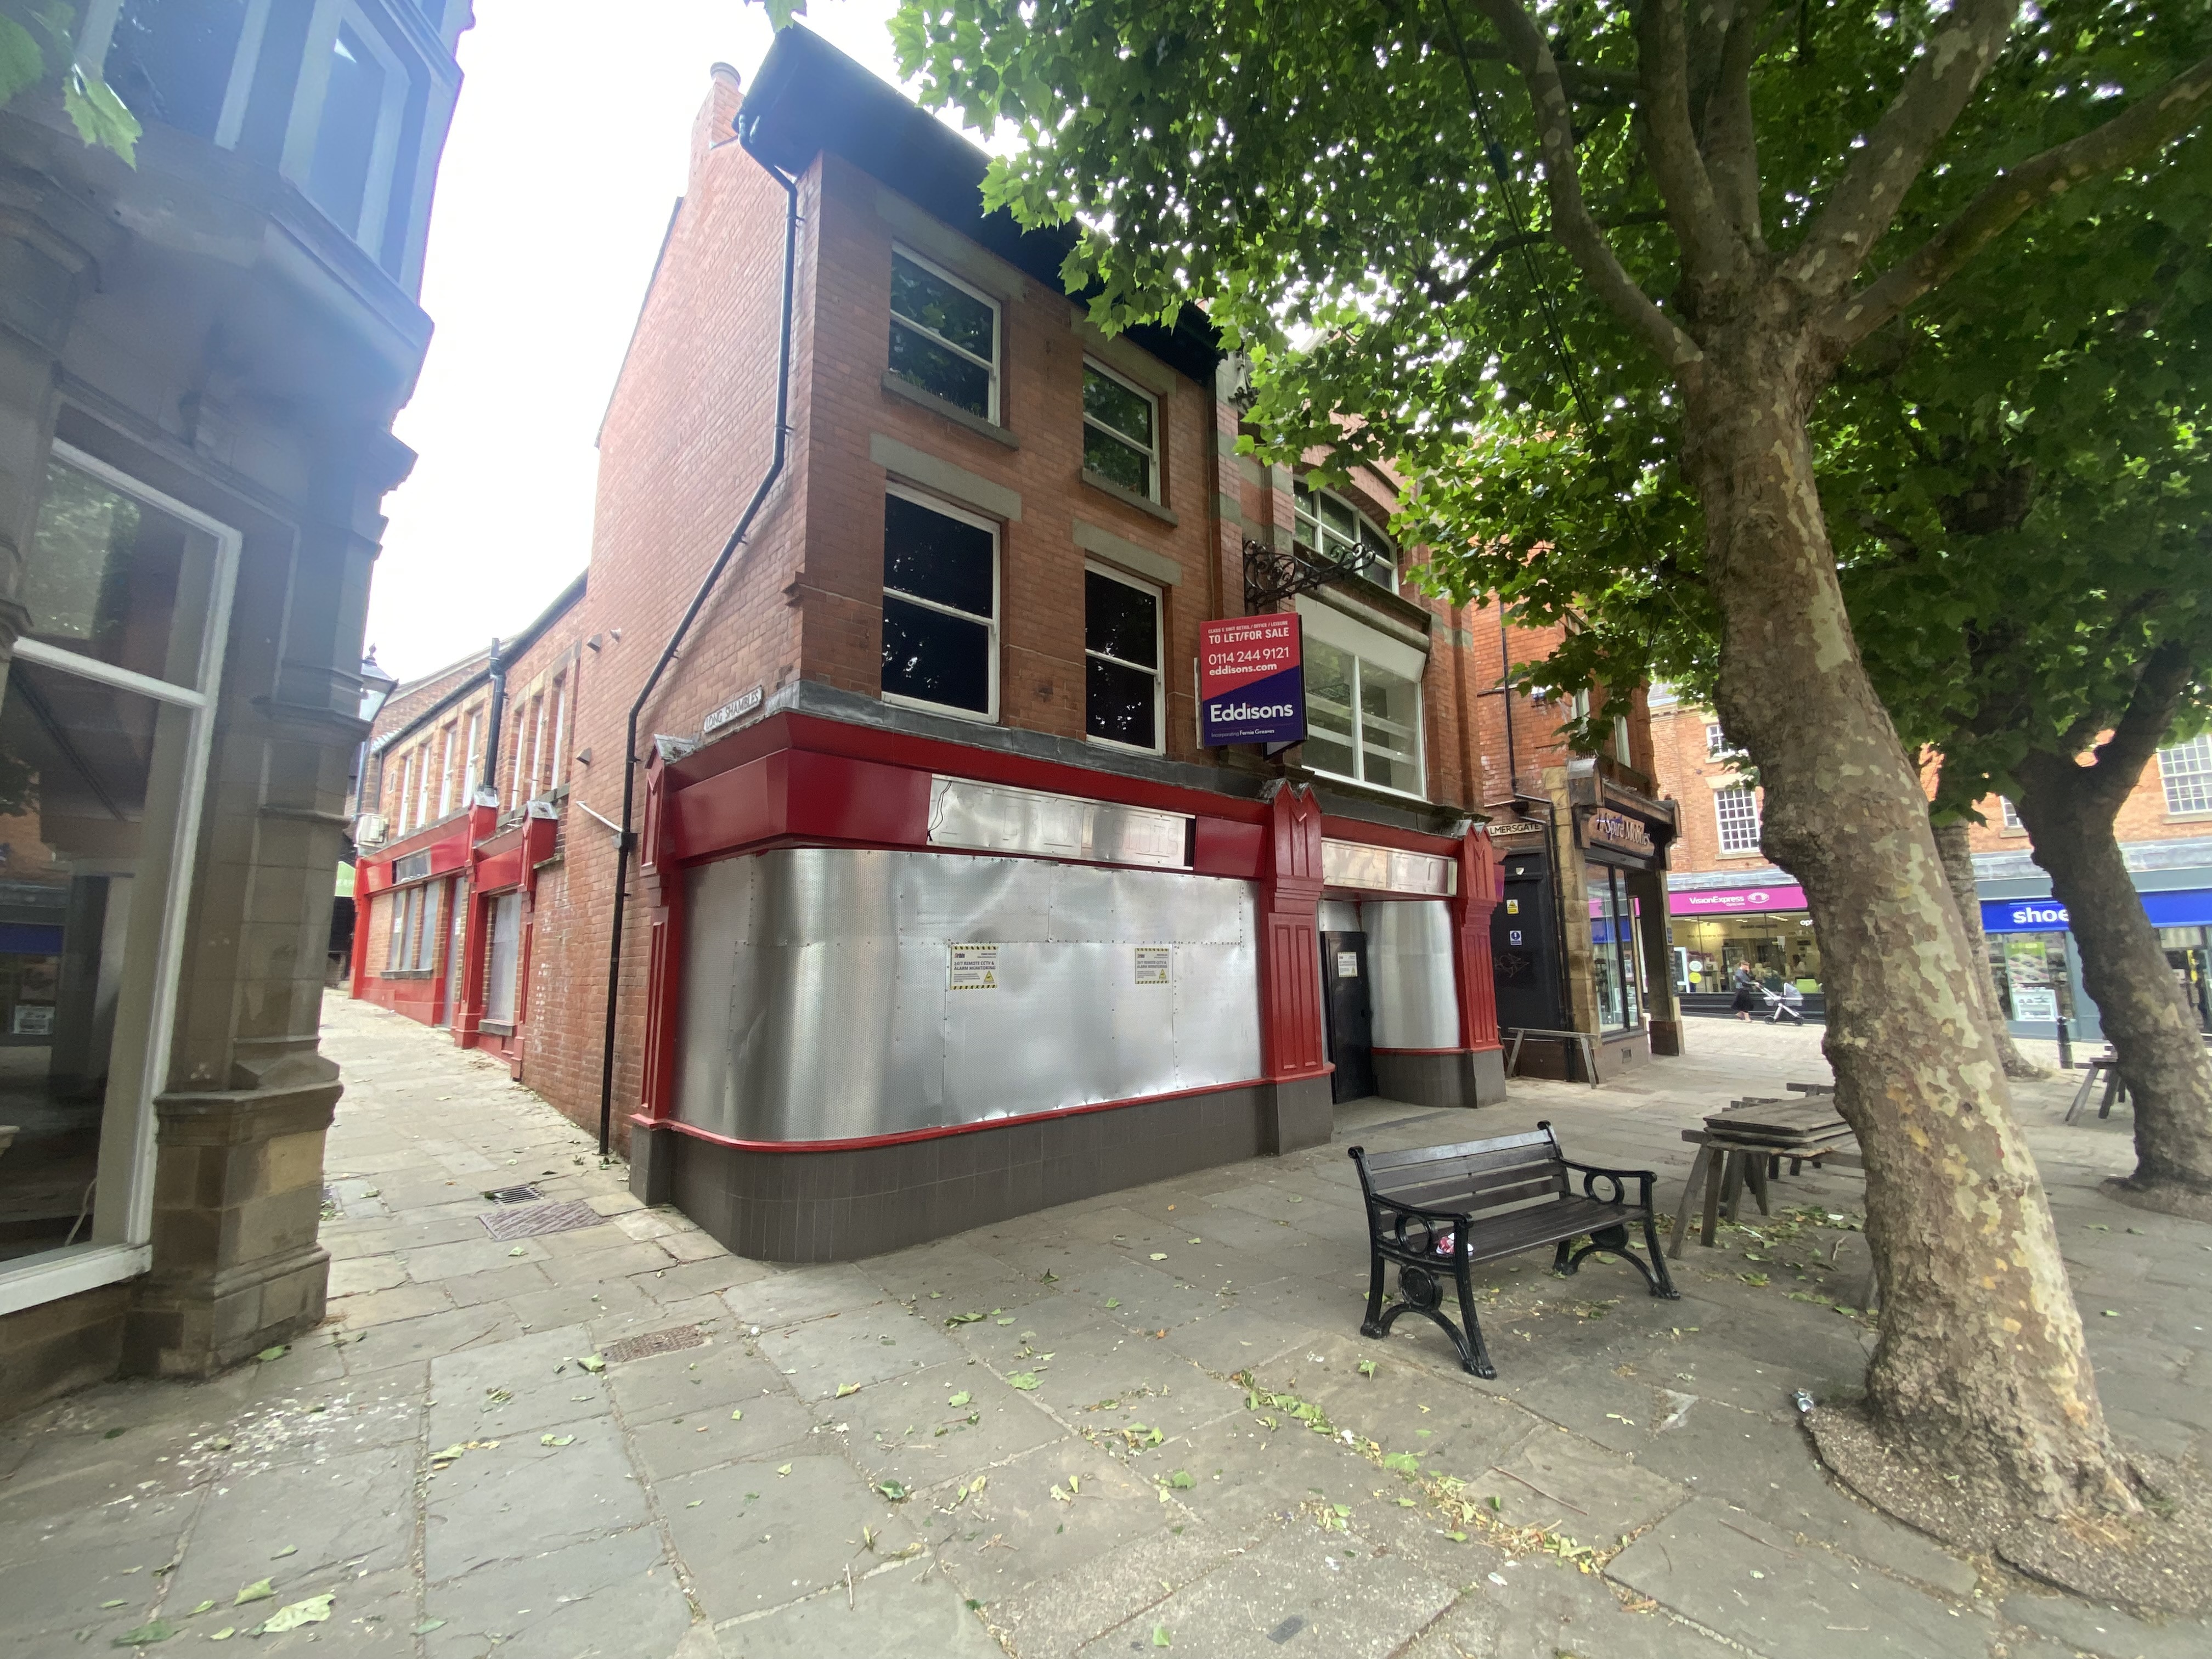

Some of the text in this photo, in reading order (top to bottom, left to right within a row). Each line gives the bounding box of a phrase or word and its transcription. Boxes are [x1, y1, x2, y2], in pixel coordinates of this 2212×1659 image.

[1209, 627, 1289, 645] TO LET/FOR SALE
[1209, 646, 1289, 665] 0114 244 9121
[1209, 663, 1277, 676] eddisons.com
[706, 690, 759, 730] LONG SHAMBLES
[1210, 702, 1294, 722] Eddisons
[2013, 907, 2069, 923] shoe
